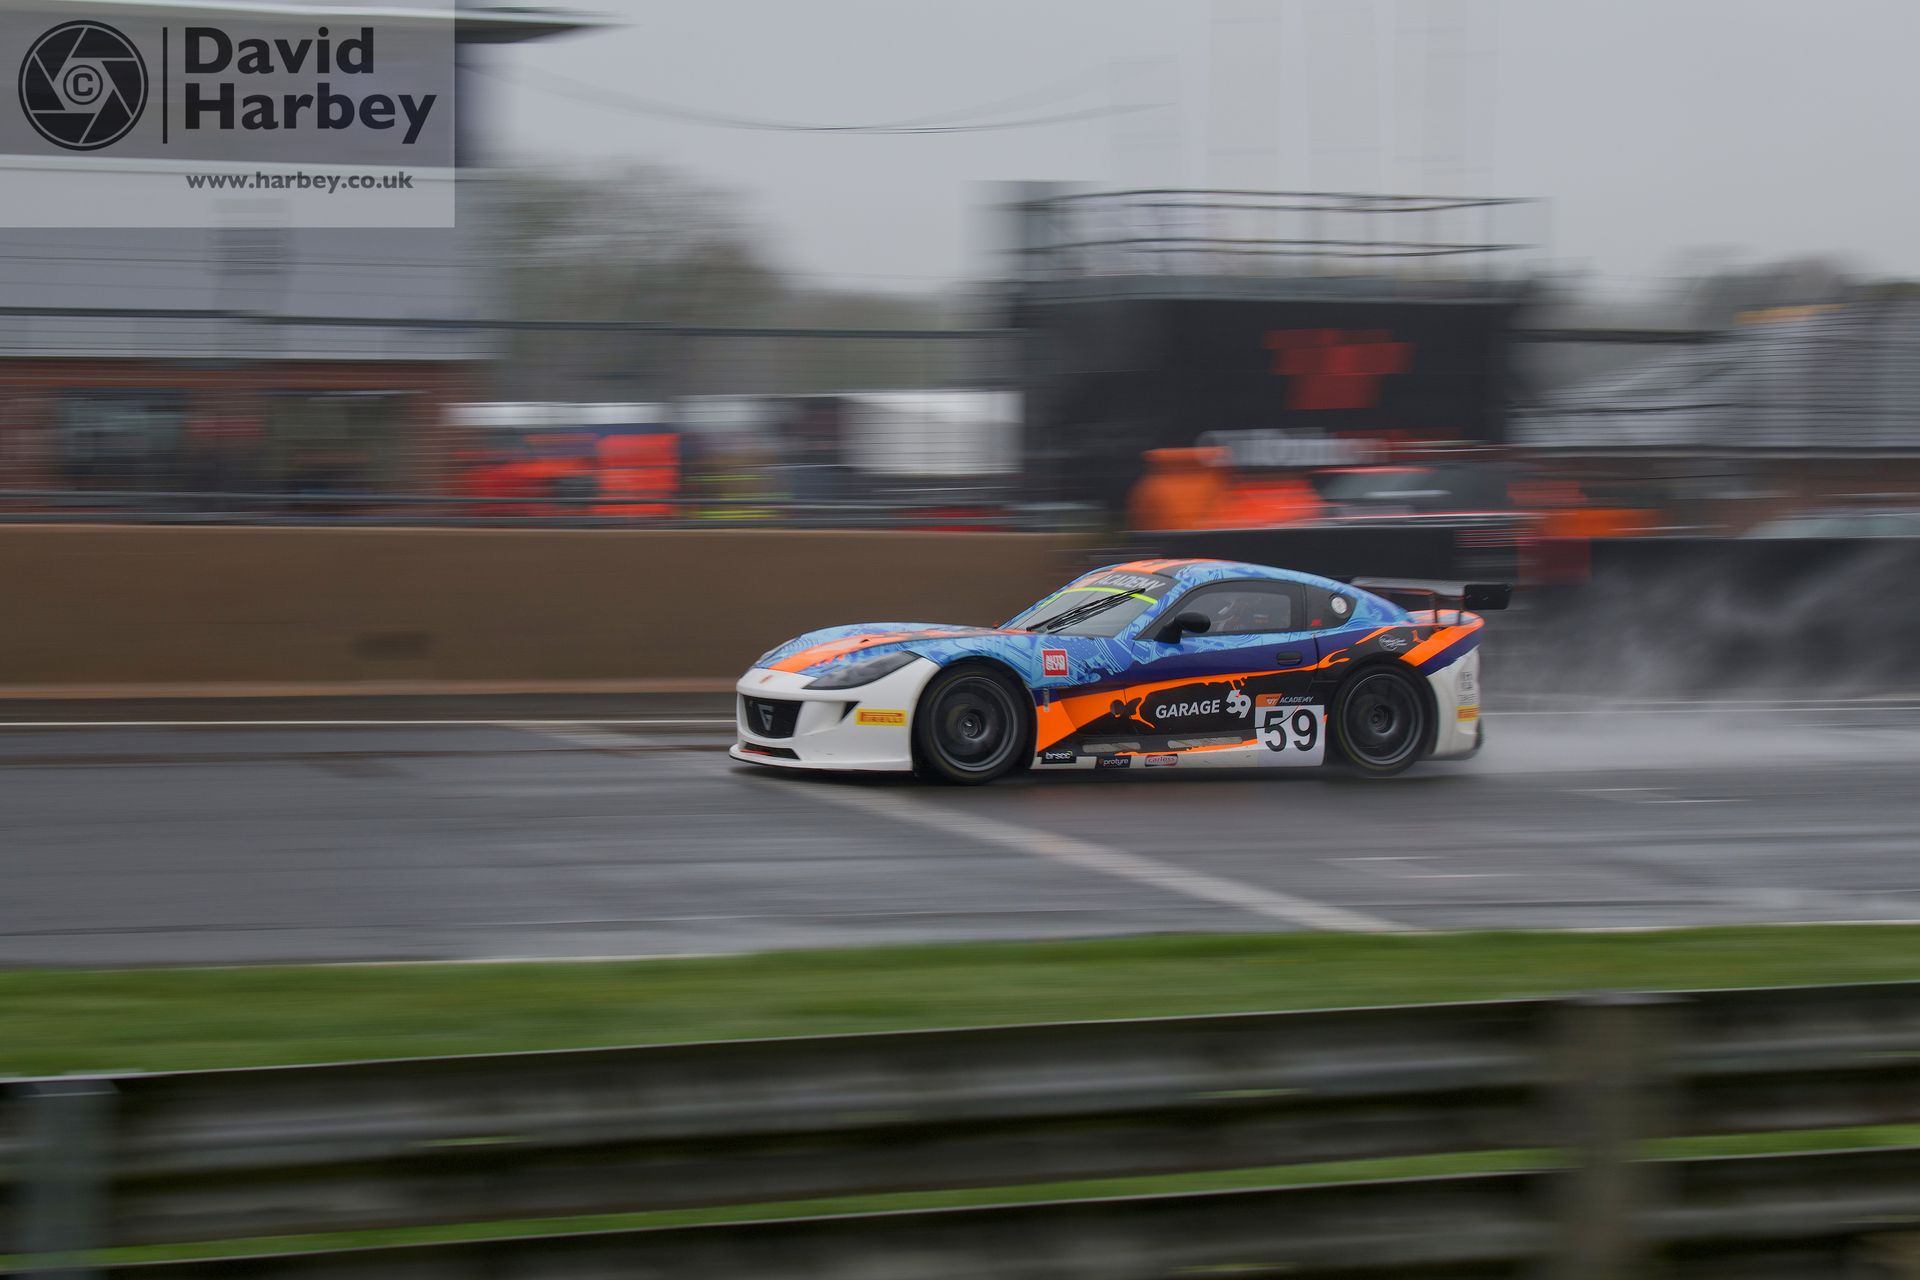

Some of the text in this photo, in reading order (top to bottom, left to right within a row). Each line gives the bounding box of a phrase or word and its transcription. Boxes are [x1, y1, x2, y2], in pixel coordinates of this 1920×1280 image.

[1155, 689, 1252, 719] GARAGE 59
[1280, 696, 1314, 704] ACADEMY
[1264, 708, 1318, 752] 59
[1103, 757, 1129, 767] protyre
